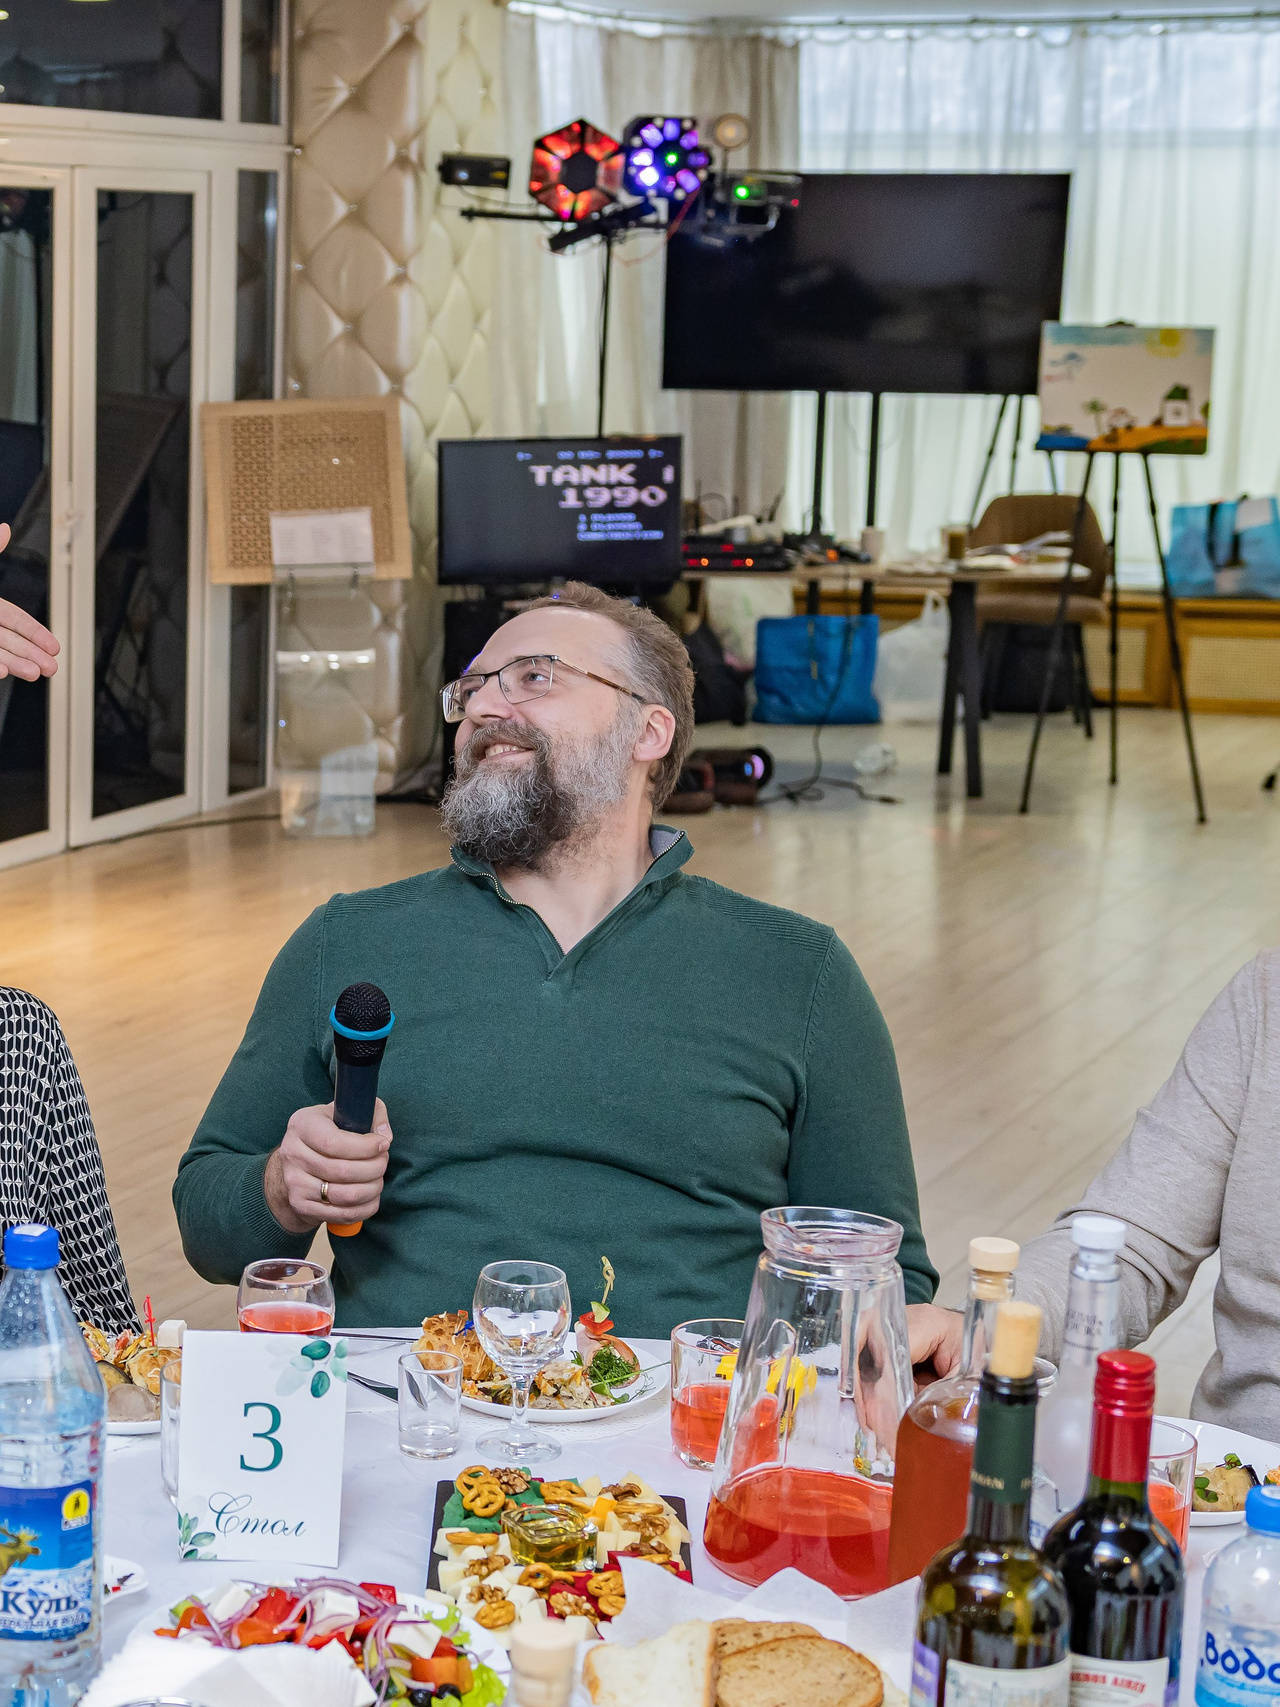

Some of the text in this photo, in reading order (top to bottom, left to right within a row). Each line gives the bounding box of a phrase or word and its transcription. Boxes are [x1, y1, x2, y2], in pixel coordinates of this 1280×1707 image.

[529, 463, 637, 486] TANK
[558, 486, 668, 508] 1990
[240, 1402, 283, 1472] 3
[208, 1491, 306, 1538] Стол
